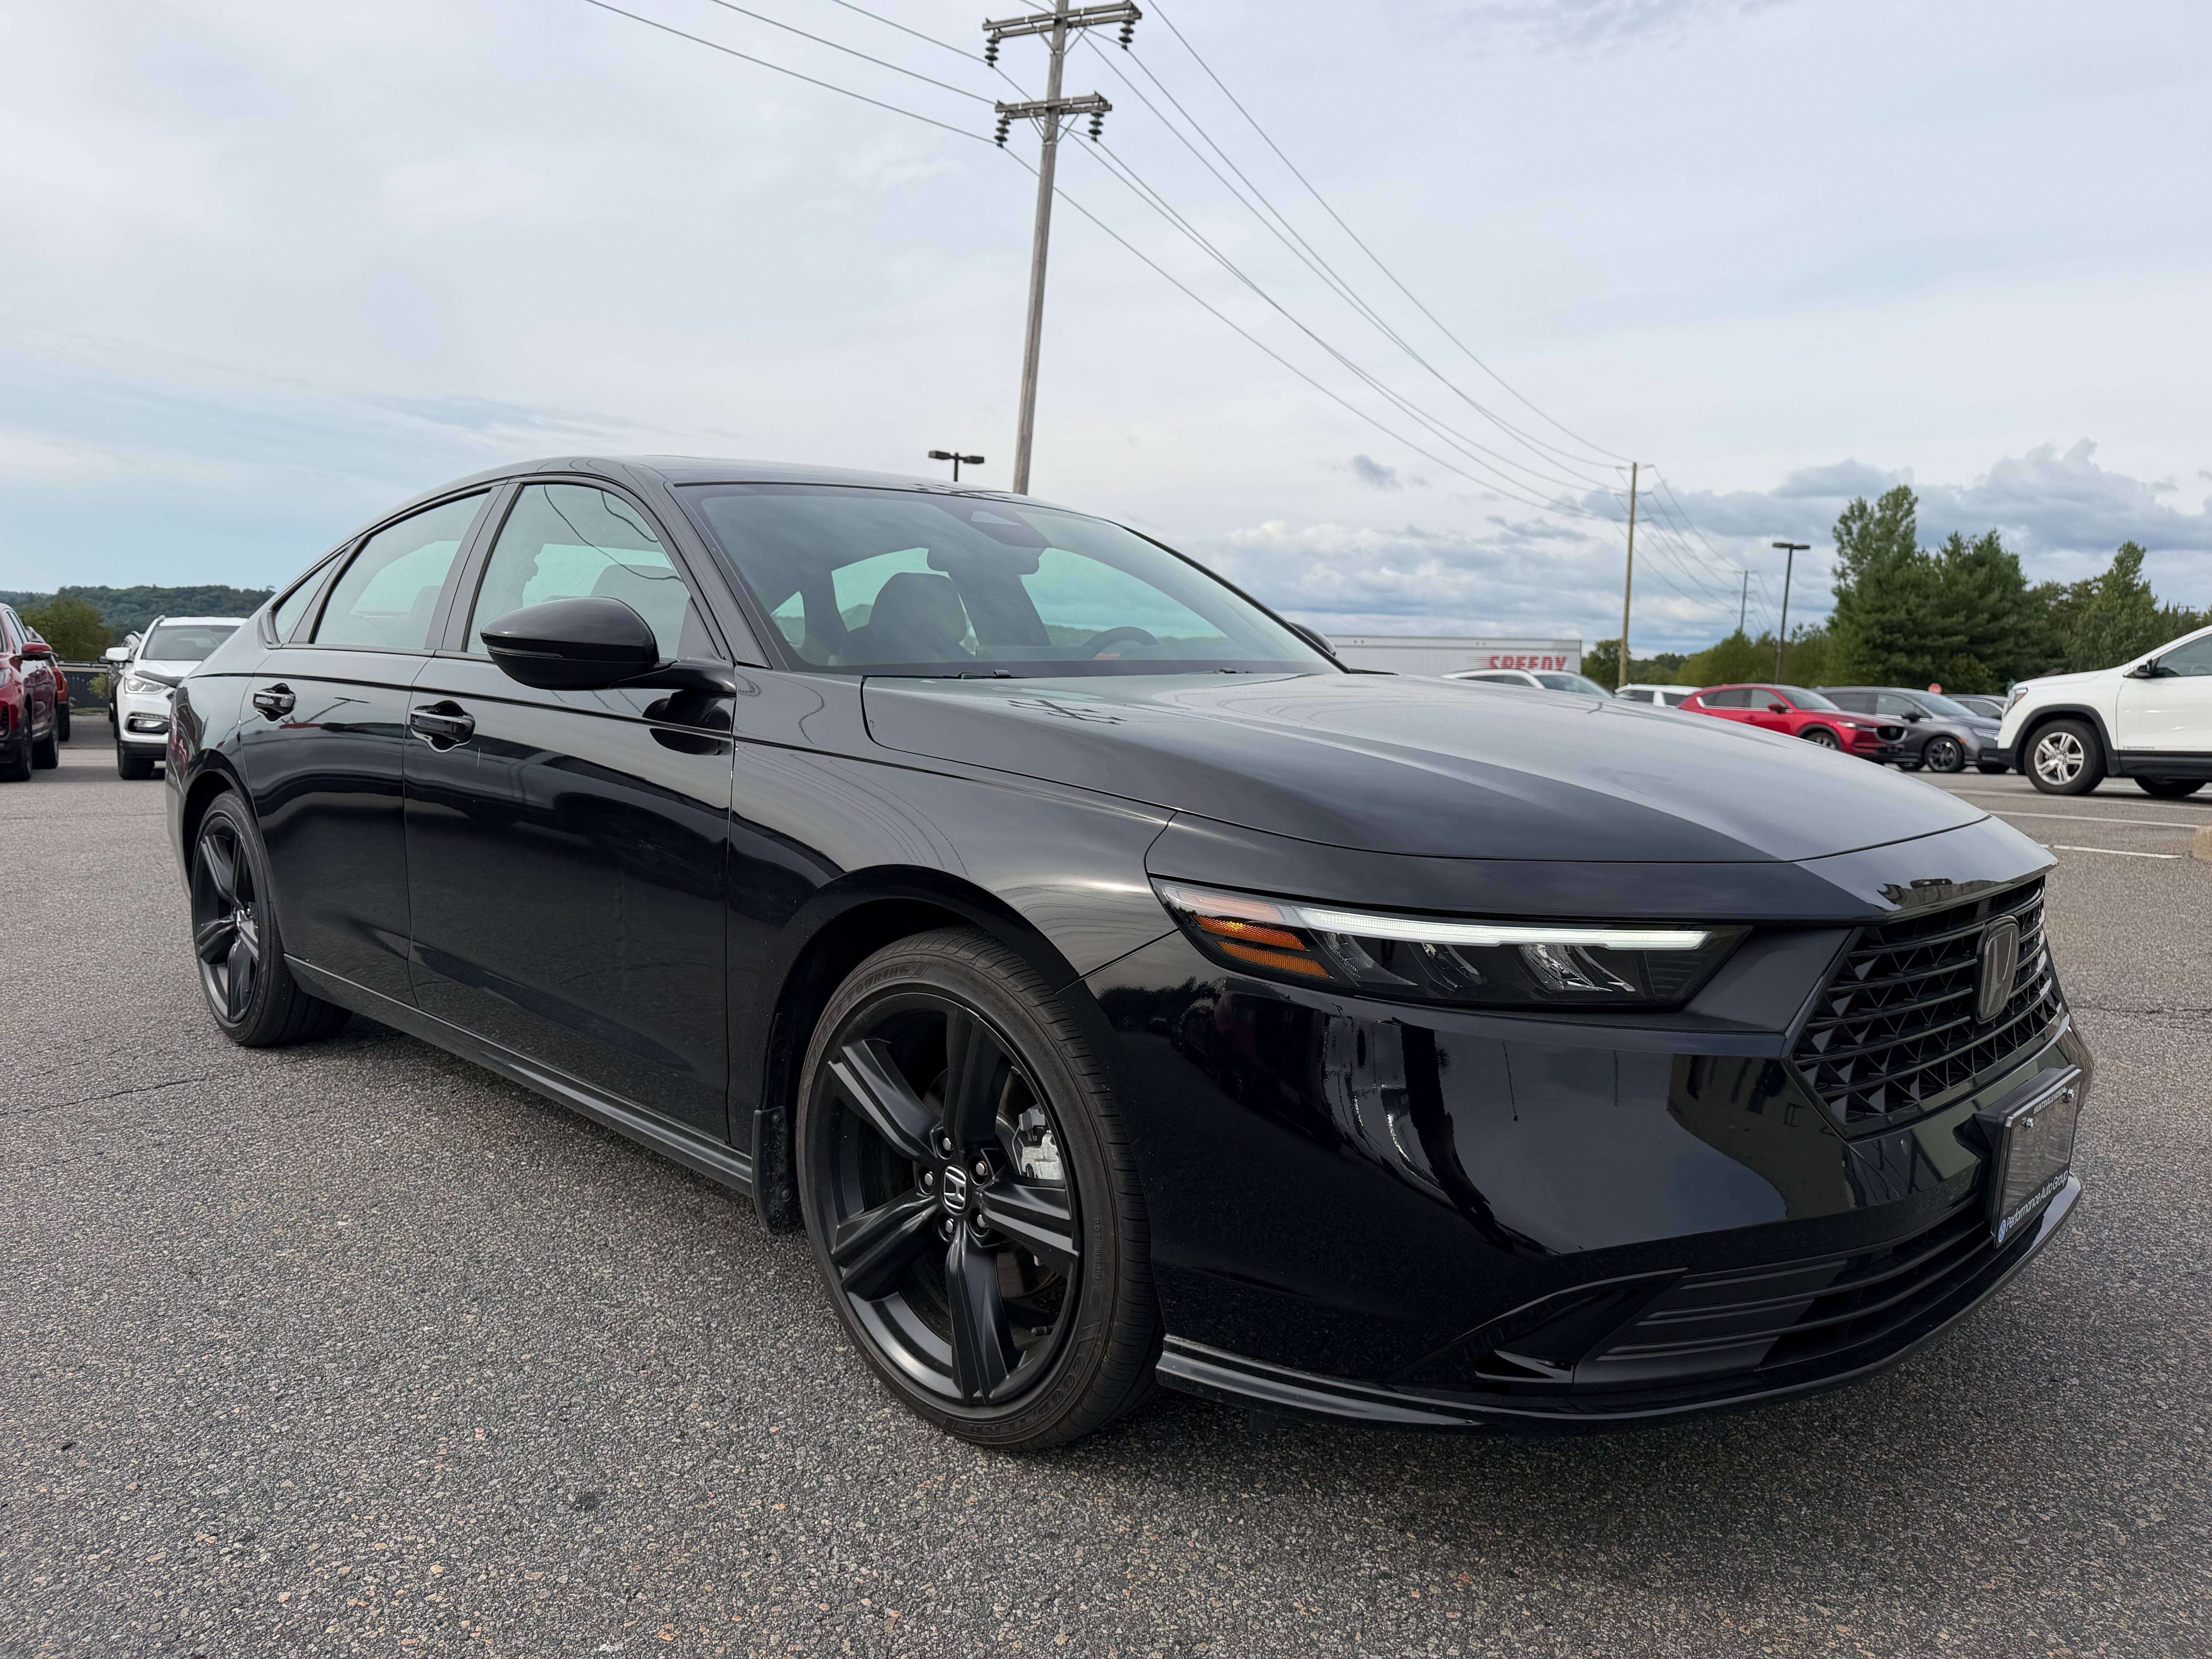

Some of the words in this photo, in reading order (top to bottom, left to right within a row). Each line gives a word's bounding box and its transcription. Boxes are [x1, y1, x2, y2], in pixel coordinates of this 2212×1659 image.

[2006, 1192, 2040, 1232] Performance
[2040, 1182, 2052, 1201] Auto
[2052, 1170, 2068, 1190] Group
